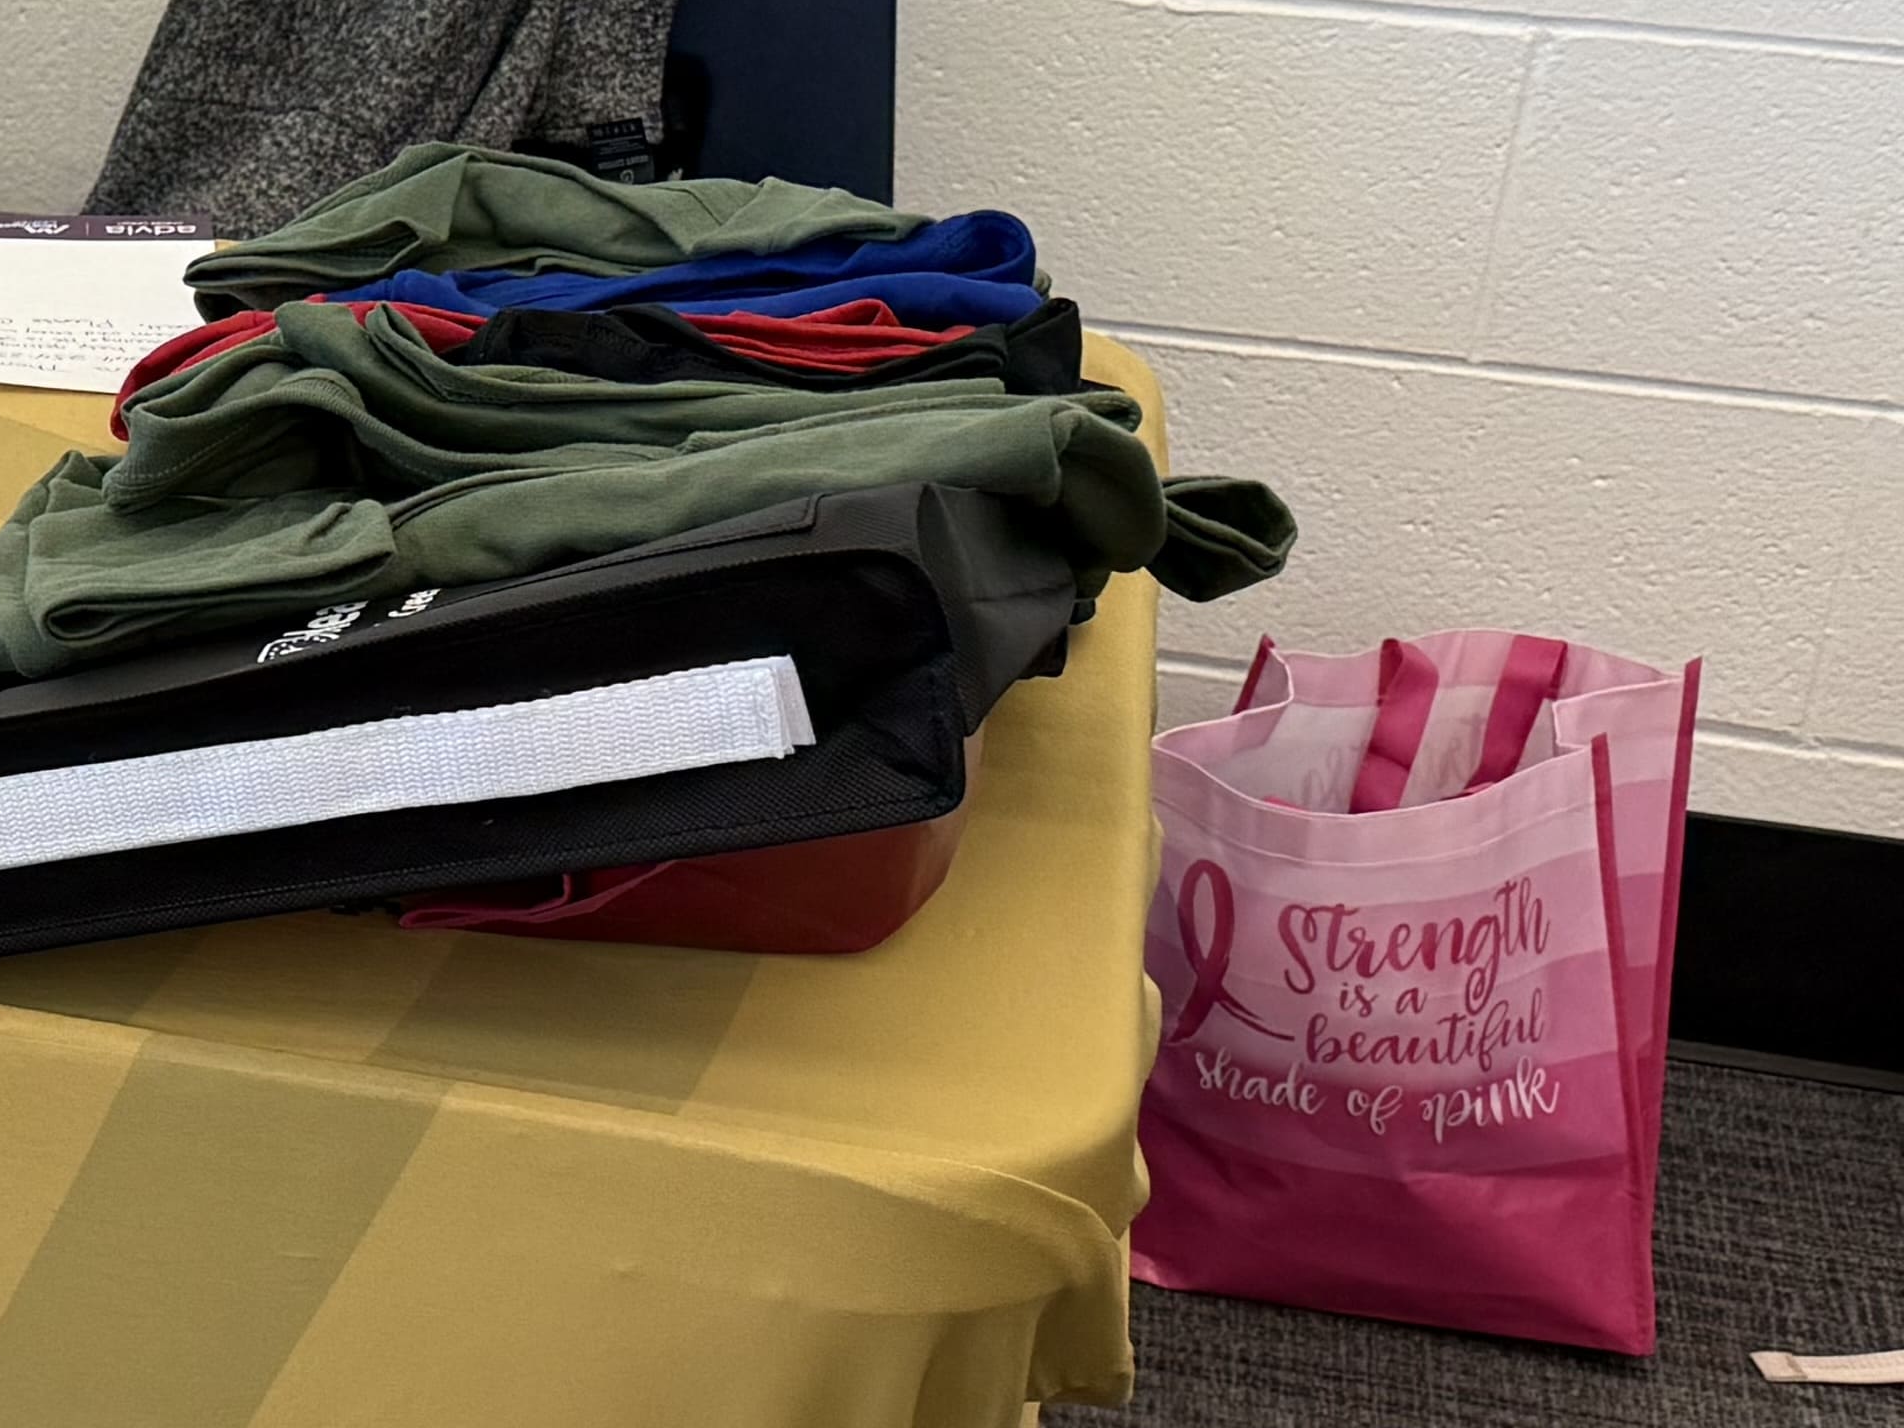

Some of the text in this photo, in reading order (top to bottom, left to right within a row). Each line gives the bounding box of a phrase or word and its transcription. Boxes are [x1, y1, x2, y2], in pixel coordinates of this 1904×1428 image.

[1276, 876, 1552, 1012] Strength
[1304, 987, 1545, 1073] beautiful
[1338, 980, 1429, 1018] is a
[1194, 1049, 1561, 1144] shade of pink
